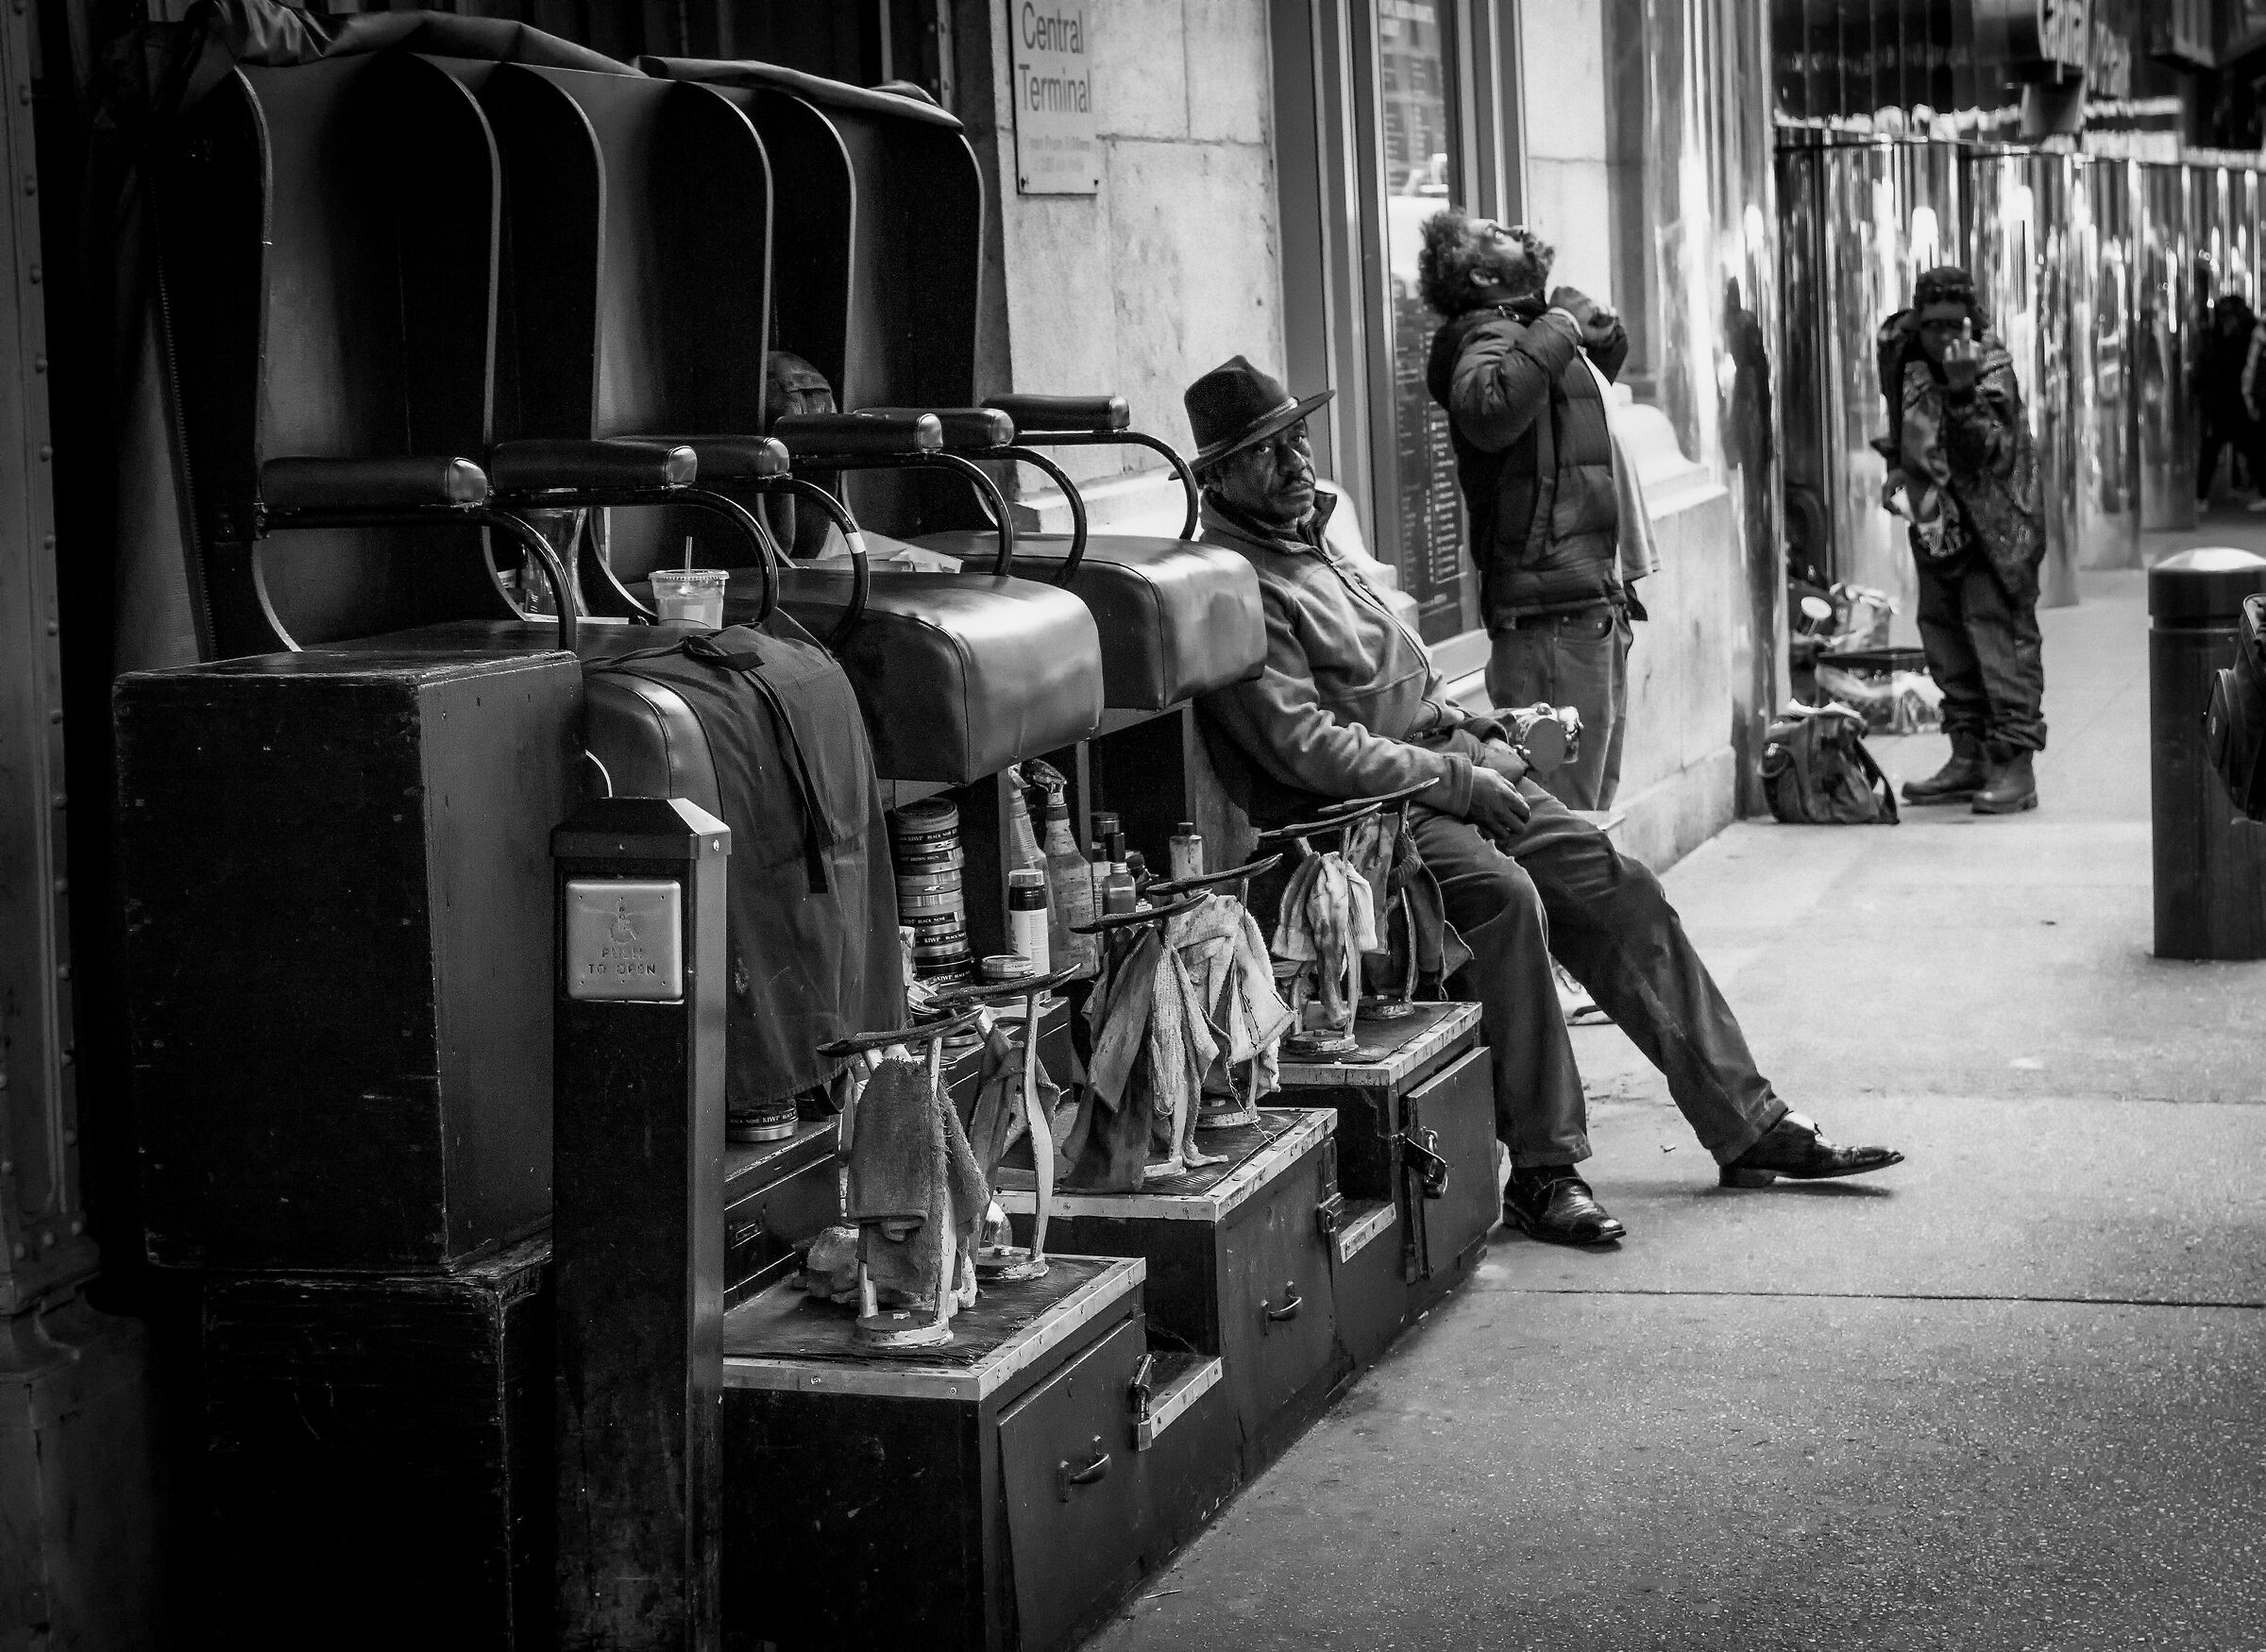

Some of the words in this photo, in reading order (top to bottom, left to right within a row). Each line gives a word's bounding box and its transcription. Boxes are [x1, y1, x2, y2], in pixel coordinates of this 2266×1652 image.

[1022, 1, 1084, 54] Central
[1019, 63, 1091, 113] Terminal
[601, 947, 643, 960] PUSH
[588, 964, 606, 974] TO
[616, 964, 656, 975] OPEN
[762, 1115, 780, 1123] KIWI
